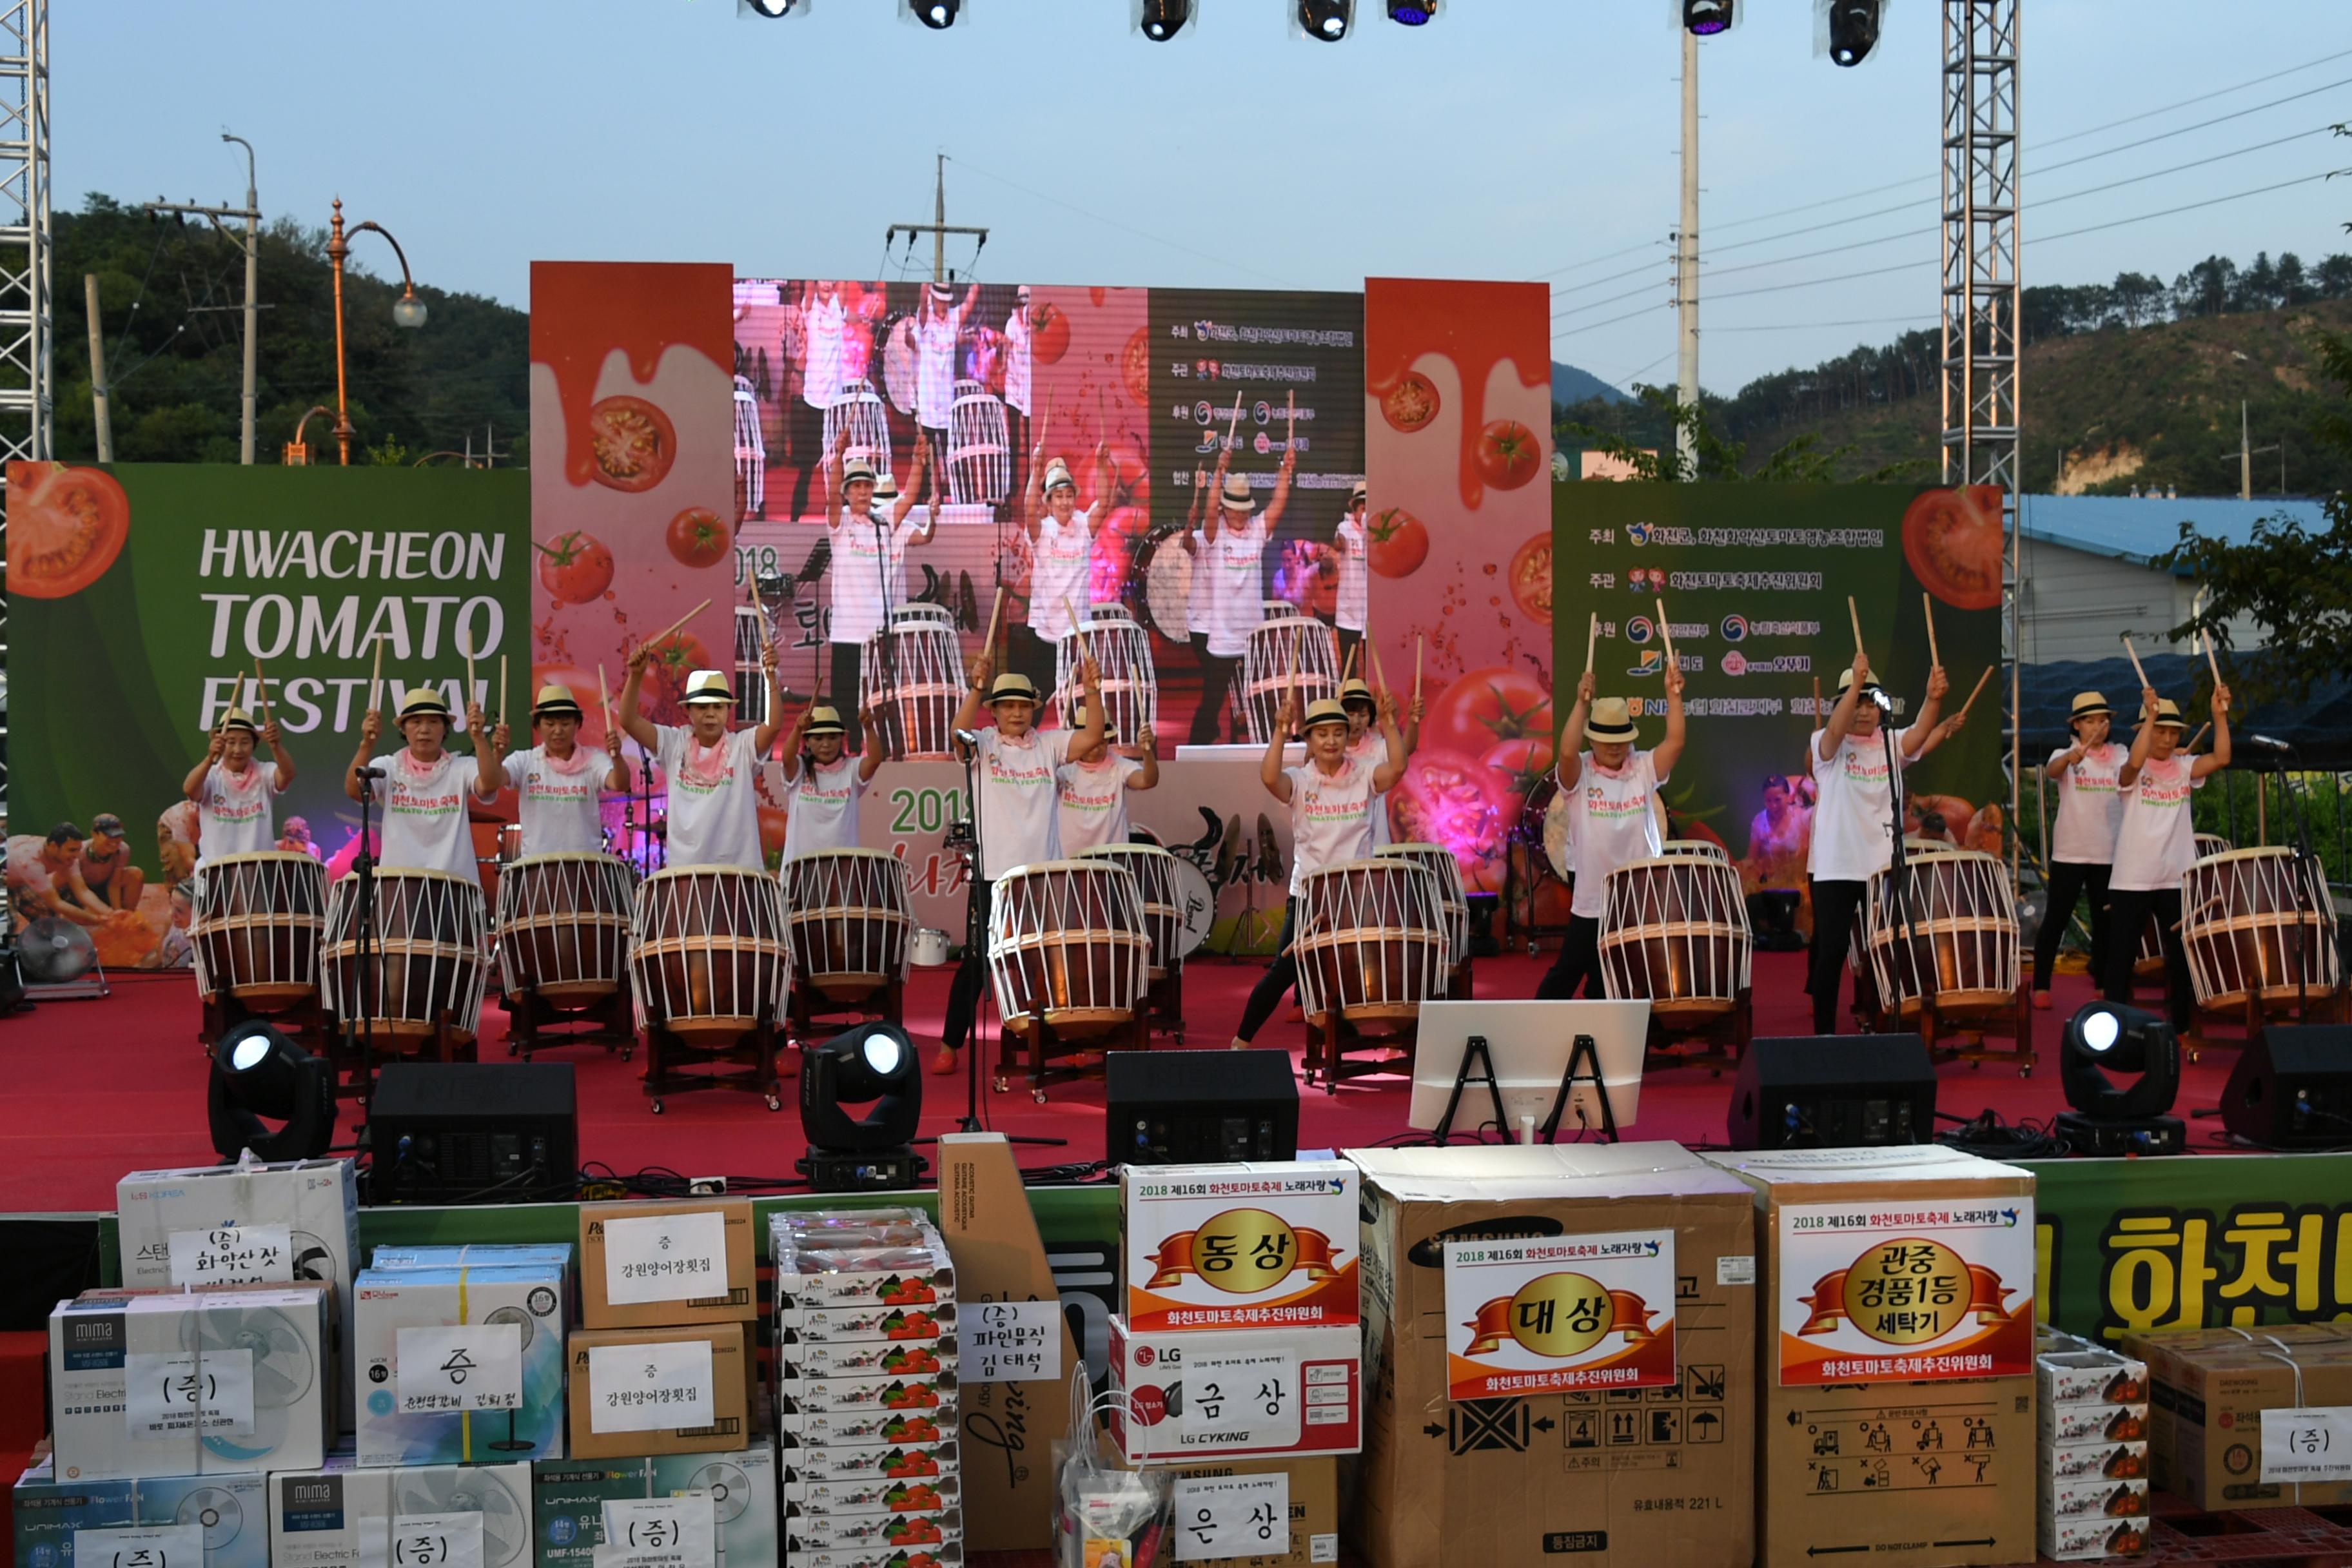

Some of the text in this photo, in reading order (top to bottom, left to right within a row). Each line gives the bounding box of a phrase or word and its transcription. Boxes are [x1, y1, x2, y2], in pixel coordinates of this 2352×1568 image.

[1589, 528, 1614, 545] 주최
[1651, 527, 1696, 545] 화천군,
[199, 528, 505, 580] HWACHEON
[1589, 572, 1823, 591] 주관 화천토마토축제추진위원회
[201, 593, 504, 660] TOMATO
[1773, 655, 1810, 672] 오뚜기
[1184, 890, 1205, 934] Pearl
[1139, 1179, 1326, 1196] 2018 제16회 화천토마토축제 노래자랑
[1793, 1210, 1998, 1229] 2018 제16회 화천토마토축제 노래자랑
[209, 1229, 240, 1250] (증)
[657, 1235, 672, 1250] 증
[1456, 1242, 1642, 1262] 2018 제16회 화천토마토축제 노래자랑
[1879, 1245, 1936, 1275] 관중
[137, 1266, 164, 1275] Electric
[621, 1257, 710, 1278] 강원양어장횟집
[1857, 1275, 1958, 1308] 경품1등
[983, 1306, 1018, 1329] (증)
[1166, 1305, 1323, 1324] 화천토마토축제추진위원회
[1875, 1311, 1939, 1335] 세탁기
[75, 1322, 113, 1338] mima
[972, 1326, 1045, 1348] 파인뮤직
[1159, 1348, 1181, 1362] LG
[370, 1369, 387, 1378] 16형
[440, 1348, 476, 1384] 증
[644, 1364, 658, 1379] 증
[1821, 1353, 1993, 1377] 화천토마토축제추진위원회
[163, 1373, 216, 1404] (증)
[1485, 1367, 1639, 1391] 화천토마토축제추진위원회
[96, 1388, 126, 1399] Electri
[605, 1386, 697, 1407] 강원양어장횟집
[1181, 1431, 1250, 1444] LG CYKING
[2289, 1429, 2329, 1453] (증)
[1581, 1456, 1600, 1467] 주의
[562, 1473, 580, 1481] 기계식
[582, 1472, 600, 1480] 선풍기
[605, 1469, 658, 1479] Flower FN
[90, 1493, 144, 1504] Flower FN
[295, 1484, 330, 1500] mima
[1633, 1496, 1723, 1511] 유효내용적 221 L
[629, 1520, 679, 1547] (증)
[314, 1550, 349, 1560] Electric
[396, 1536, 447, 1564] (증)
[1902, 1542, 1928, 1550] CLAMP
